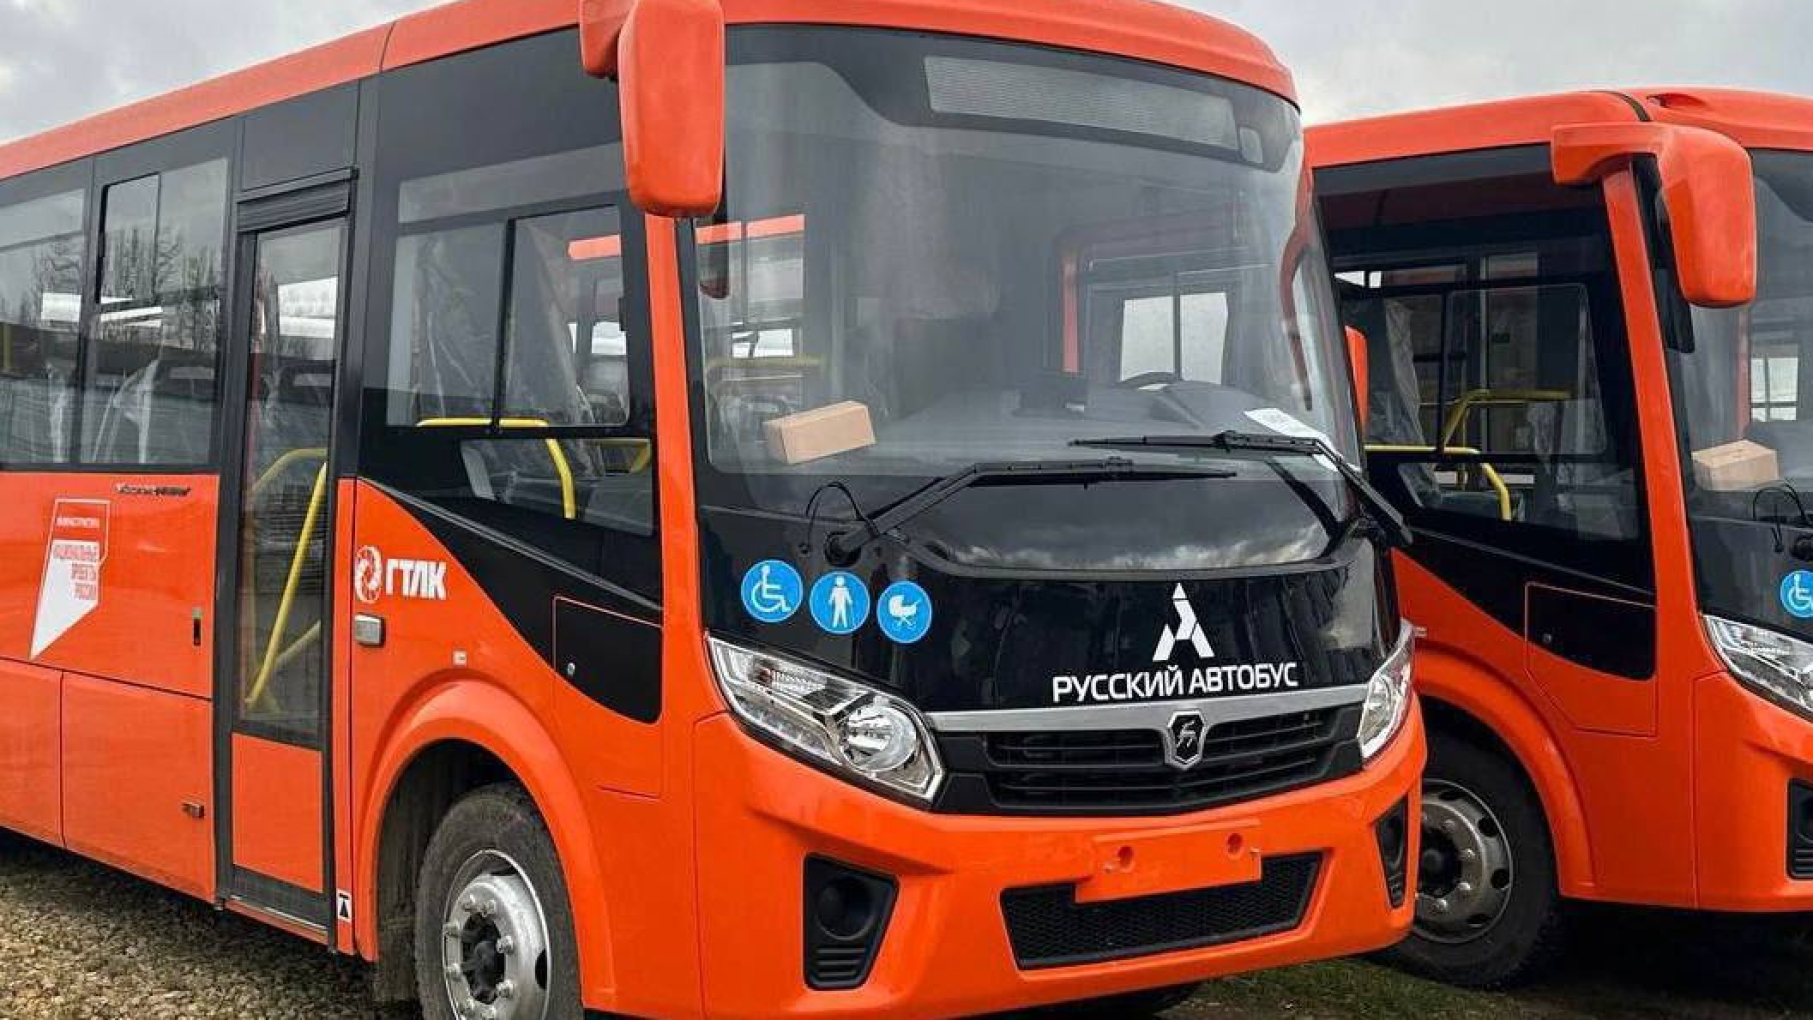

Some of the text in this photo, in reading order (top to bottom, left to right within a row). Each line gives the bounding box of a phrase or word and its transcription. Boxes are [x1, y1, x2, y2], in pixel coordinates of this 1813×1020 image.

[385, 558, 447, 600] ГТЛК
[1052, 662, 1299, 702] РУССКИЙ АВТОБУС
